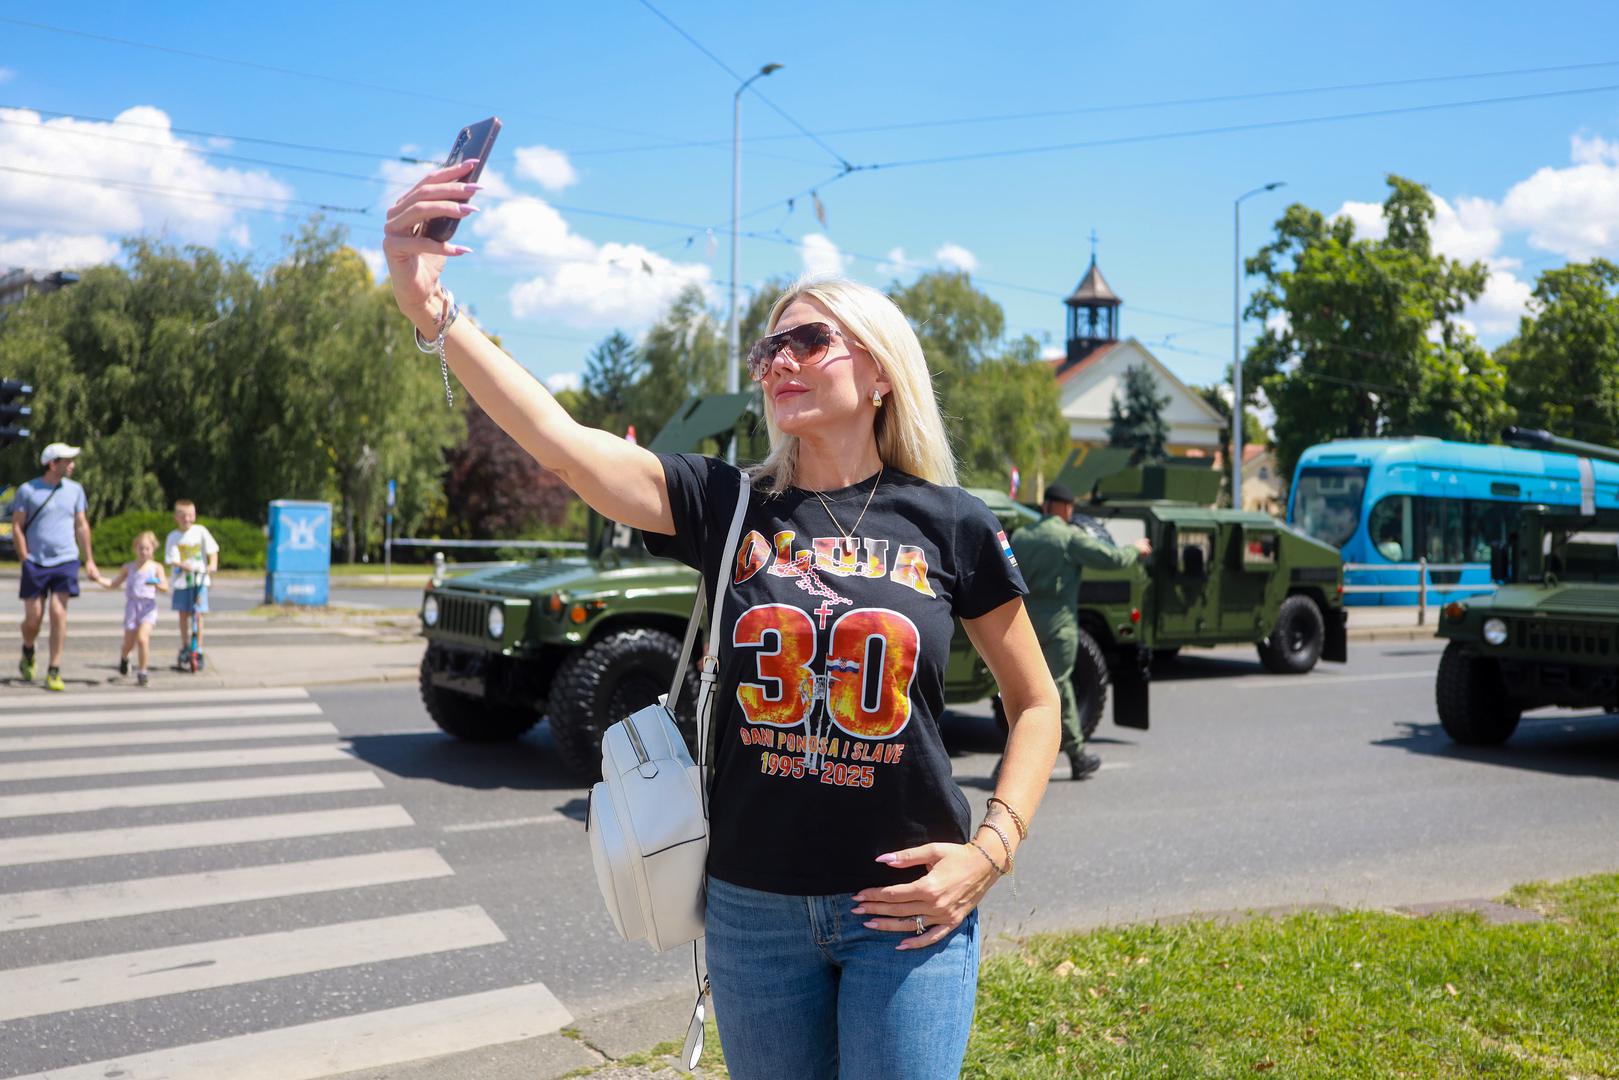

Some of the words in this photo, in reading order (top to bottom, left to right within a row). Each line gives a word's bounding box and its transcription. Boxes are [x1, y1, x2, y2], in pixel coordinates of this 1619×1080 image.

[733, 530, 936, 599] OLUJA
[733, 603, 920, 739] 30
[777, 732, 839, 757] PONOSA
[850, 744, 904, 764] SLAVE
